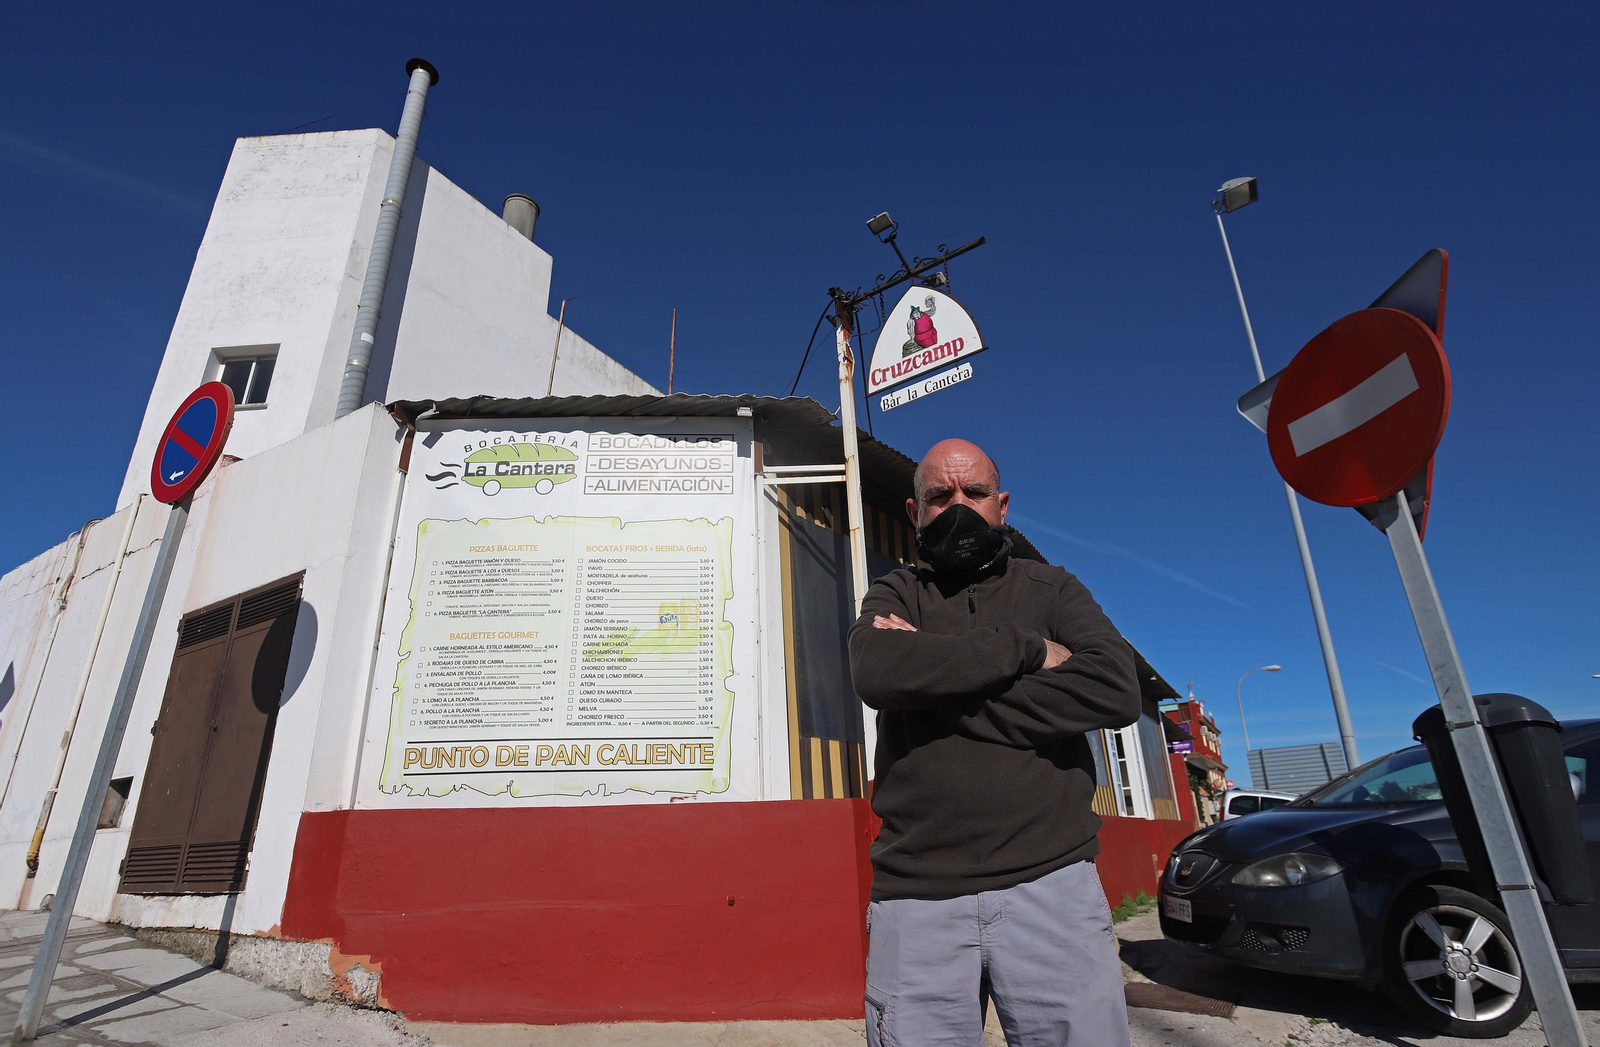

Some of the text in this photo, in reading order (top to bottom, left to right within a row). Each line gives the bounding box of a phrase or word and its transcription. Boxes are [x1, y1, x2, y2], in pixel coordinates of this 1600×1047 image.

[882, 368, 970, 411] Bar la Cantera
[464, 434, 579, 453] BOCATERÍA
[464, 461, 576, 476] La Cantera
[687, 545, 707, 553] (lata)
[450, 631, 539, 640] BAGUETTES GOURMET
[403, 743, 715, 769] PUNTO DE PAN CALIENTE
